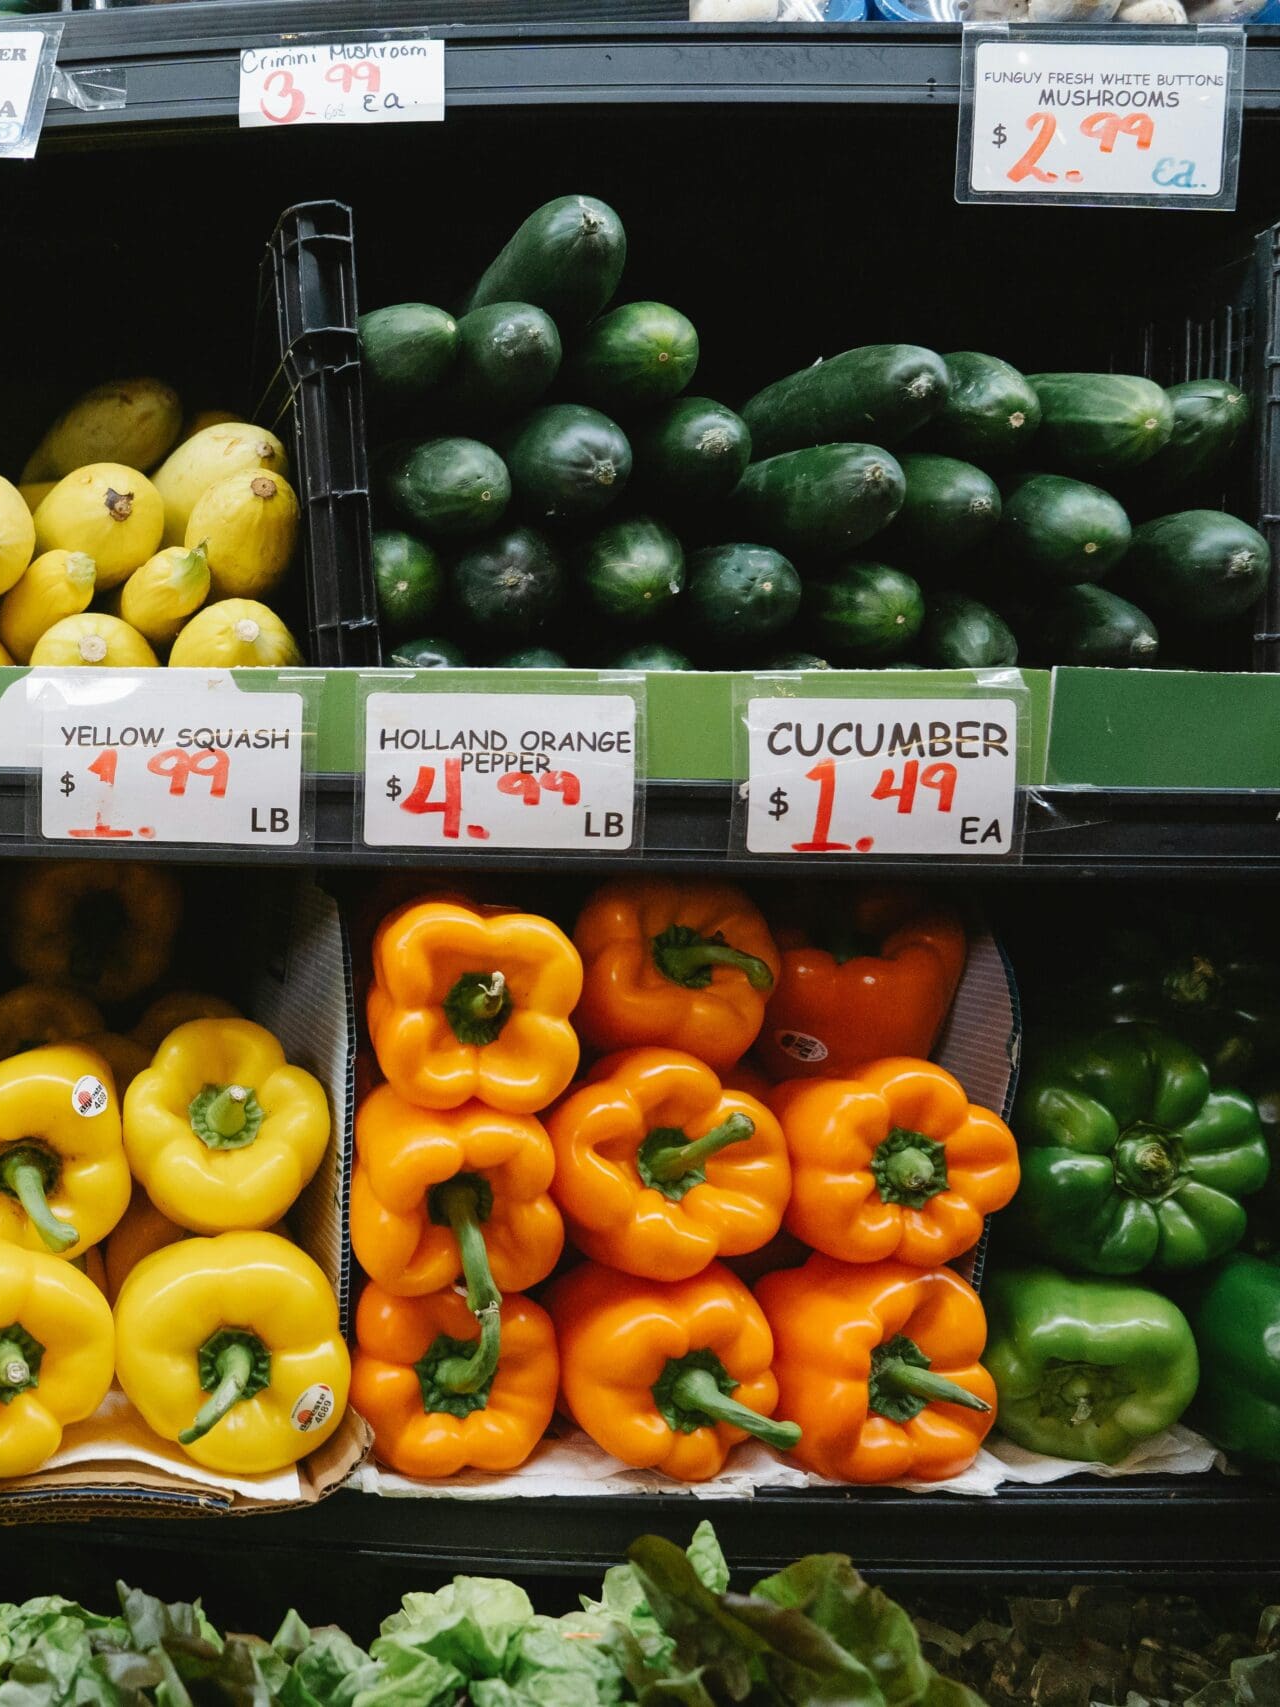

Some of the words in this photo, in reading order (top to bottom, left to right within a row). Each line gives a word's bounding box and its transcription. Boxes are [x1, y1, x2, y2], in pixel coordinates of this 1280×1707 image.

[241, 49, 317, 73] Crimini
[329, 44, 427, 61] Mushroom
[984, 72, 1042, 84] FUNGUY
[1048, 73, 1094, 85] FRESH
[1100, 73, 1151, 86] WHITE
[1157, 74, 1224, 87] BUTTONS
[1038, 89, 1180, 108] MUSHROOMS
[61, 725, 165, 748] YELLOW
[175, 727, 290, 753] SQUASH
[380, 728, 508, 751] HOLLAND
[520, 730, 632, 754] ORANGE
[767, 721, 1009, 759] CUCUMBER
[461, 752, 551, 775] PEPPER
[251, 807, 290, 833] LB
[584, 811, 624, 838] LB
[960, 816, 1002, 845] EA
[315, 1400, 332, 1424] 4689
